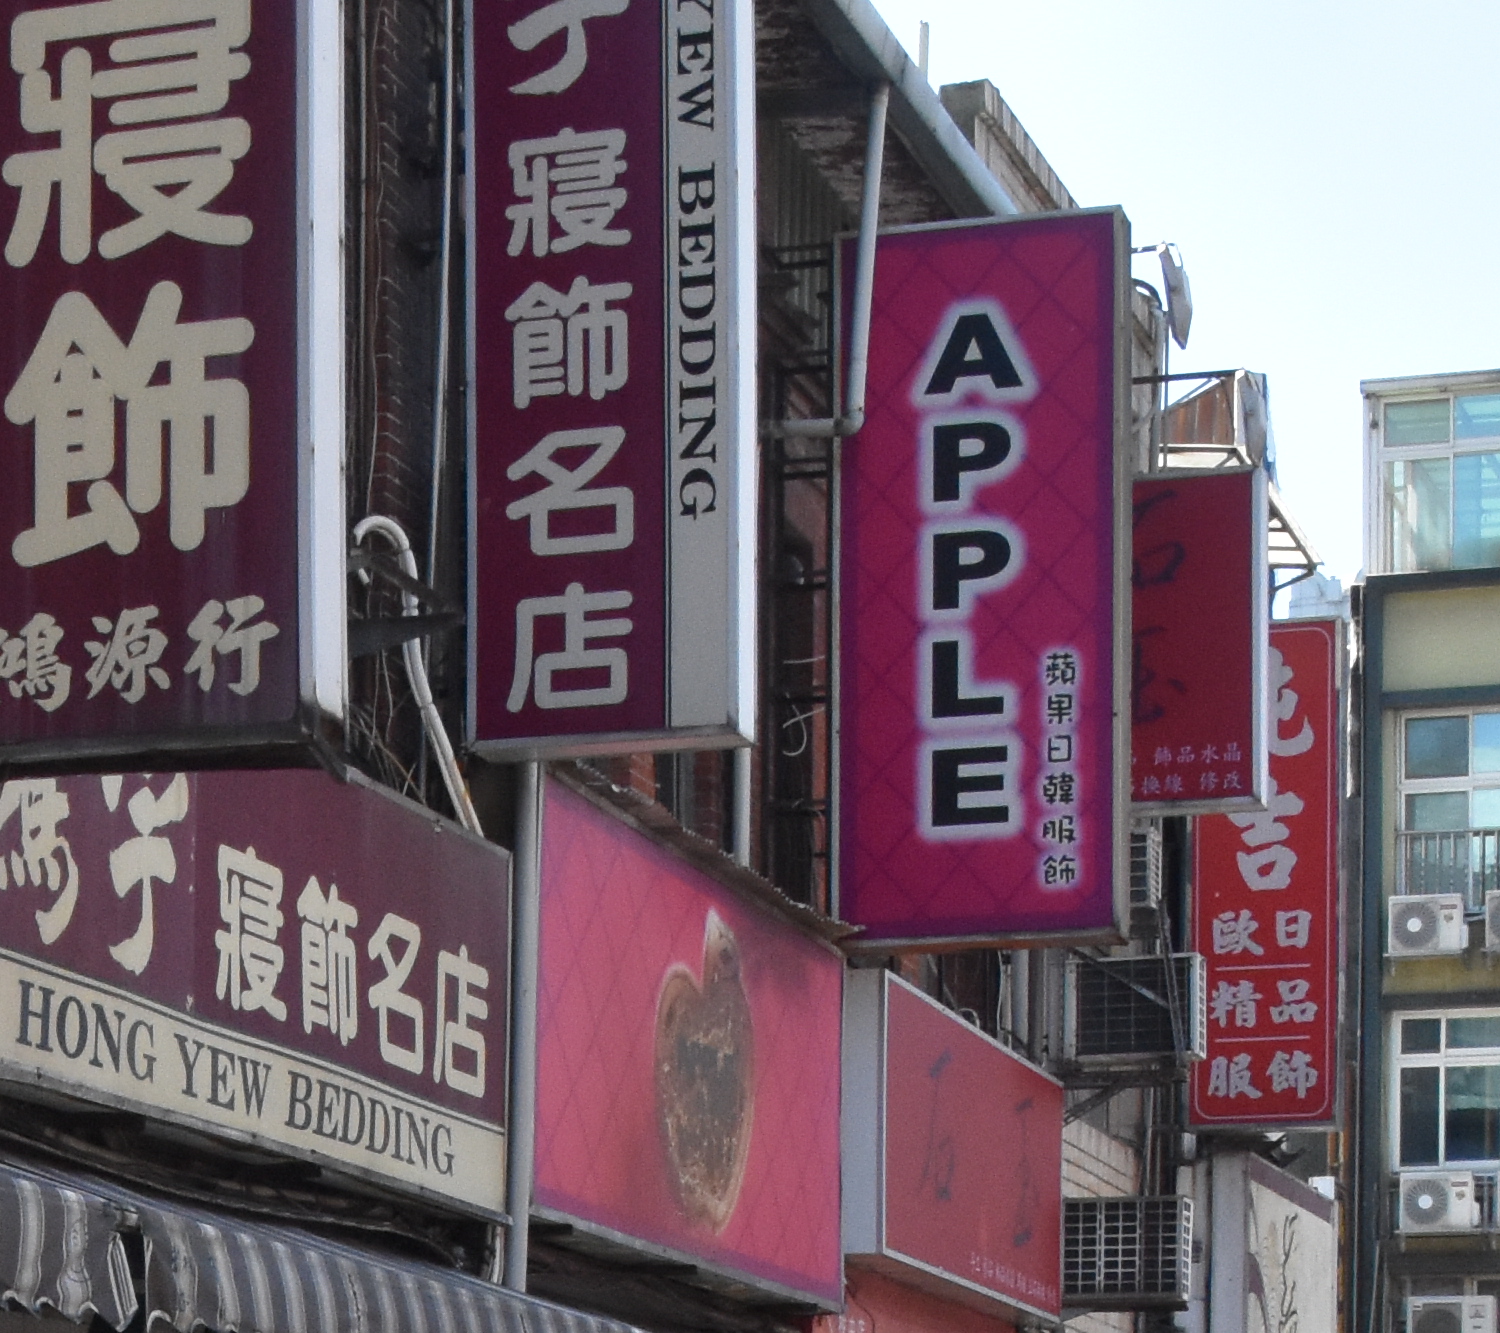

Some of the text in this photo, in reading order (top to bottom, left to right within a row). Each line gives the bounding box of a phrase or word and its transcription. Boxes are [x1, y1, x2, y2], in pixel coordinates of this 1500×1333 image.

[678, 164, 717, 522] BEDDING
[921, 309, 1026, 830] APPLE
[1041, 652, 1077, 886] 蘋果日韓服飾
[1209, 978, 1319, 1032] 精品
[1211, 907, 1312, 958] 歐日
[16, 979, 455, 1178] HONG YEW BEDDING
[1208, 1050, 1319, 1102] 服飾
